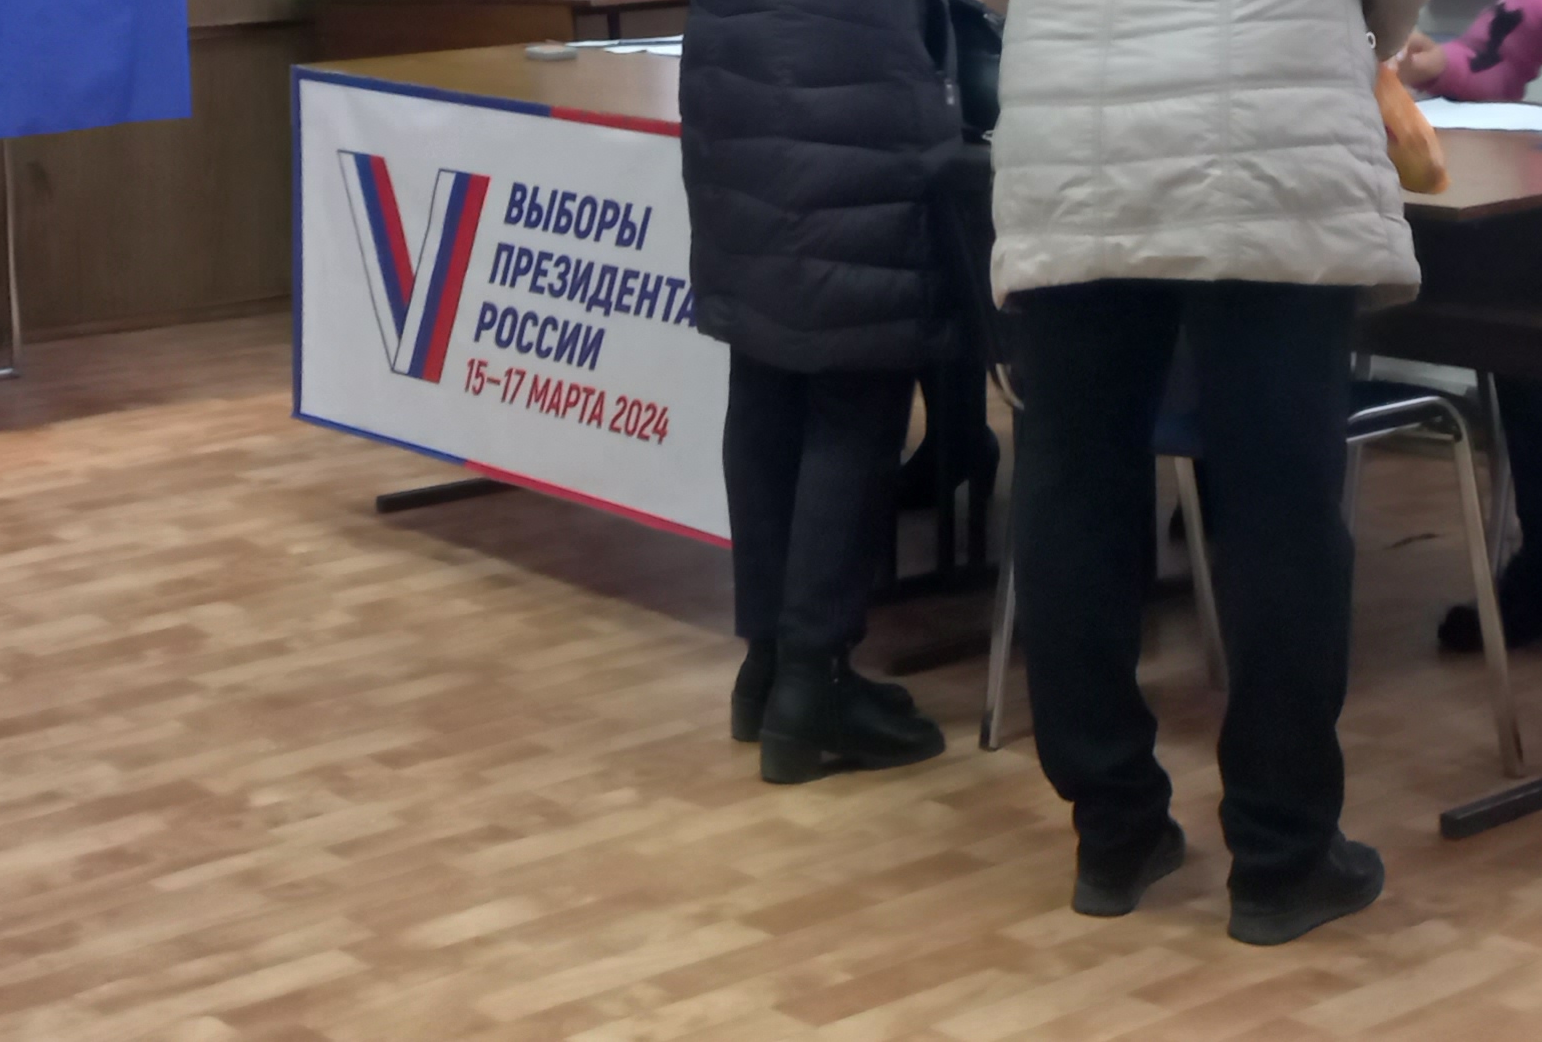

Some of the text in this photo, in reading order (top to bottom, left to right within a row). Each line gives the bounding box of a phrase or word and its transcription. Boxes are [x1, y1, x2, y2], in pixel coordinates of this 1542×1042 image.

[503, 181, 653, 251] ВЫБОРЫ
[488, 242, 699, 328] ПРЕЗИДЕНТА
[473, 301, 606, 370] РОССИИ
[526, 374, 606, 428] МАРТА
[609, 395, 671, 445] 2024
